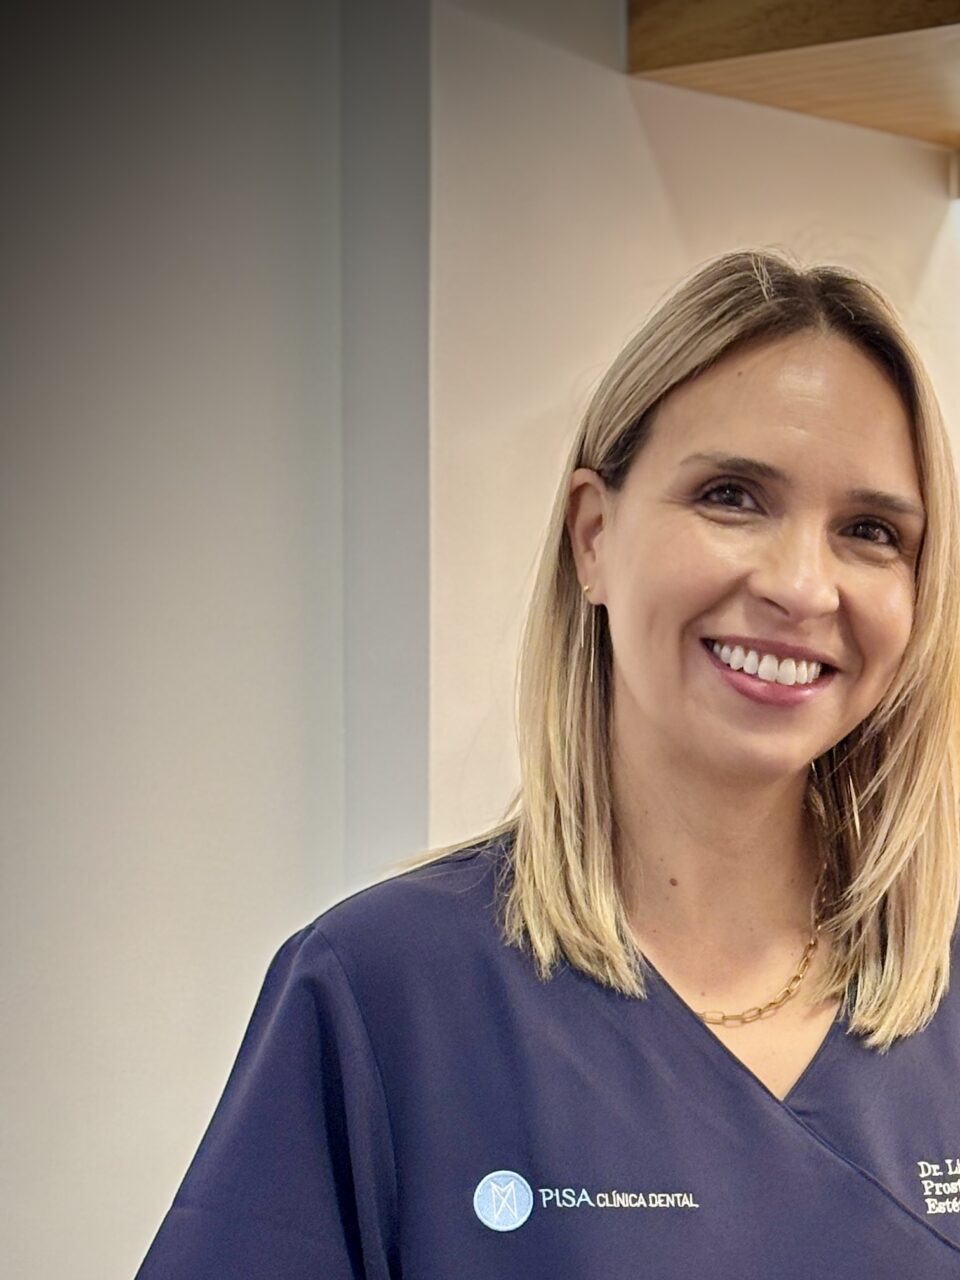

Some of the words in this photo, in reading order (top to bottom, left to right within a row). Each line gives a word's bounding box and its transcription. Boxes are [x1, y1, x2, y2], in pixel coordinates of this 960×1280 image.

[917, 1161, 943, 1178] Dr.
[538, 1188, 595, 1208] PISA
[596, 1190, 646, 1208] CLÍNICA
[648, 1193, 699, 1208] DENTAL
